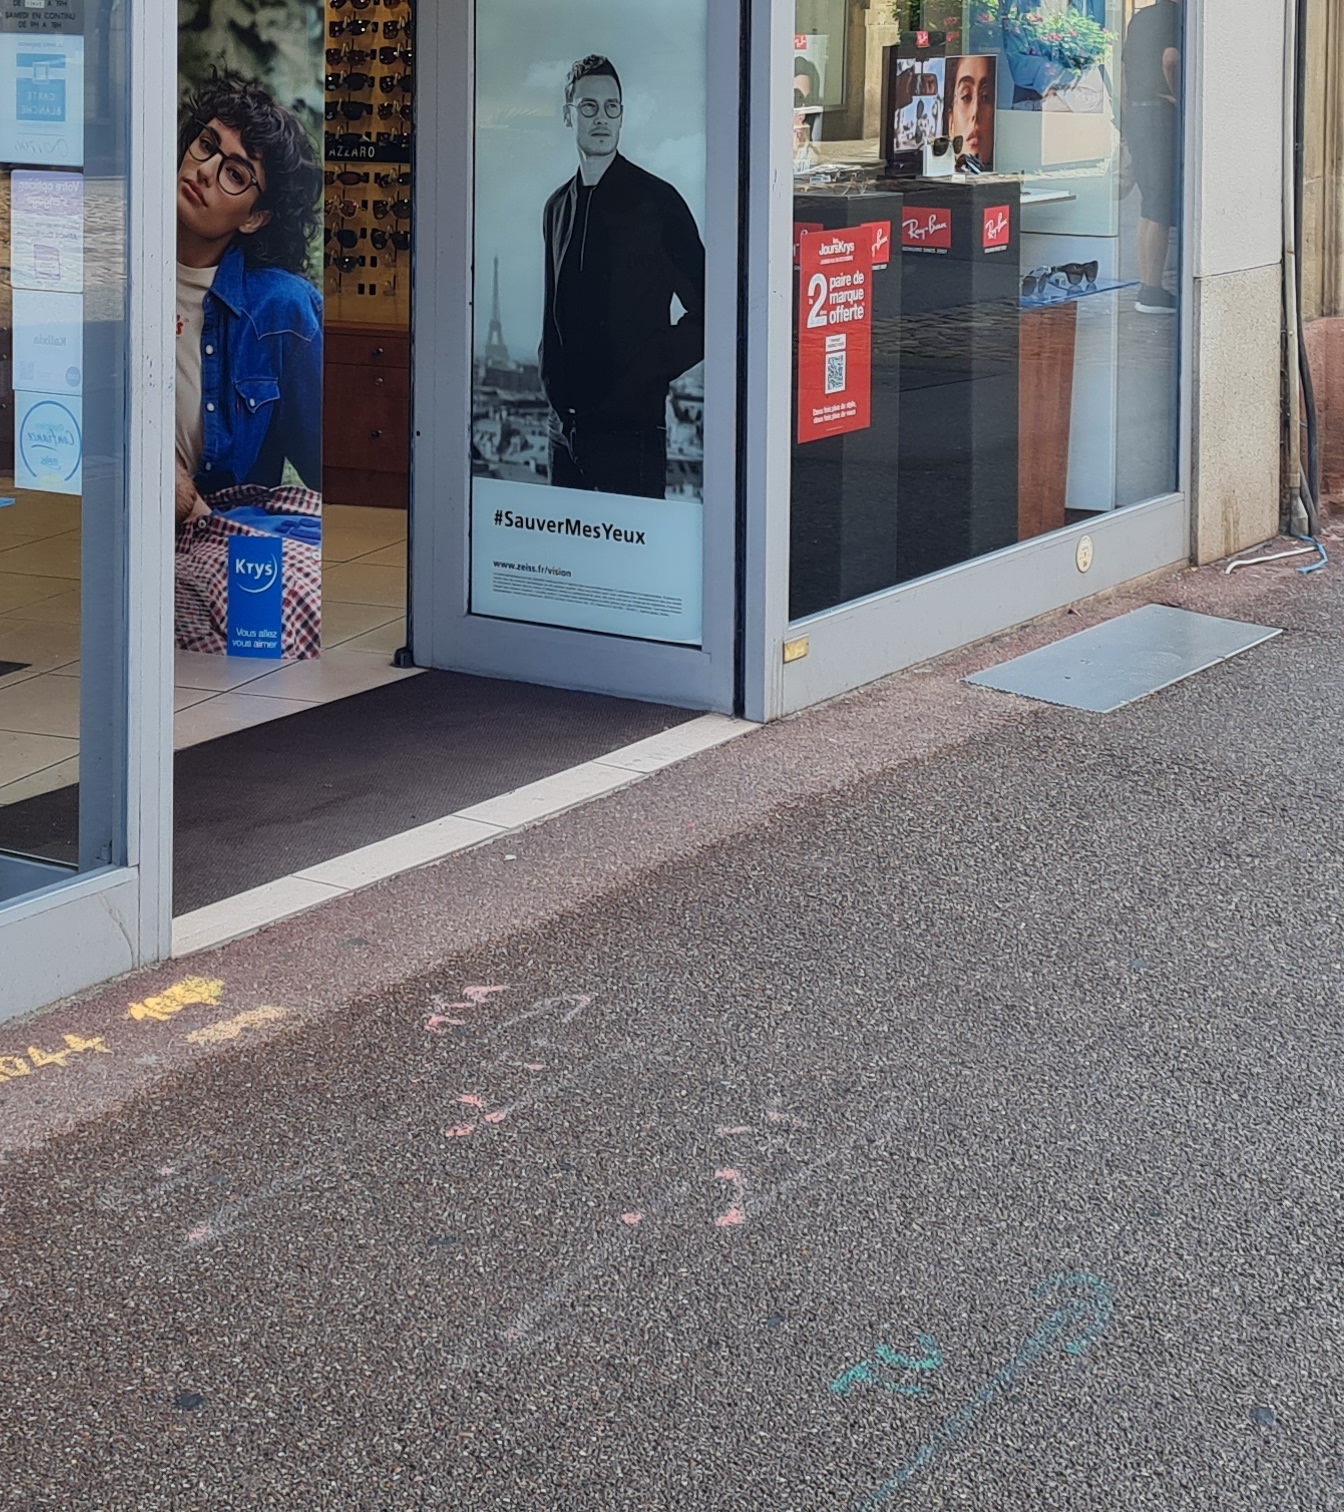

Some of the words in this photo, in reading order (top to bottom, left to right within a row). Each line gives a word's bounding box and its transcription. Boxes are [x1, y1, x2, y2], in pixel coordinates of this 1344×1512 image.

[902, 214, 948, 240] Ray-Ban
[829, 271, 852, 292] paire
[853, 269, 865, 285] de
[806, 272, 828, 329] 2
[829, 288, 865, 305] marque
[493, 509, 646, 546] #SauverMesYeux
[235, 558, 273, 580] Krys
[492, 560, 572, 578] www.zeiss.fr/vision
[236, 627, 256, 637] Vous
